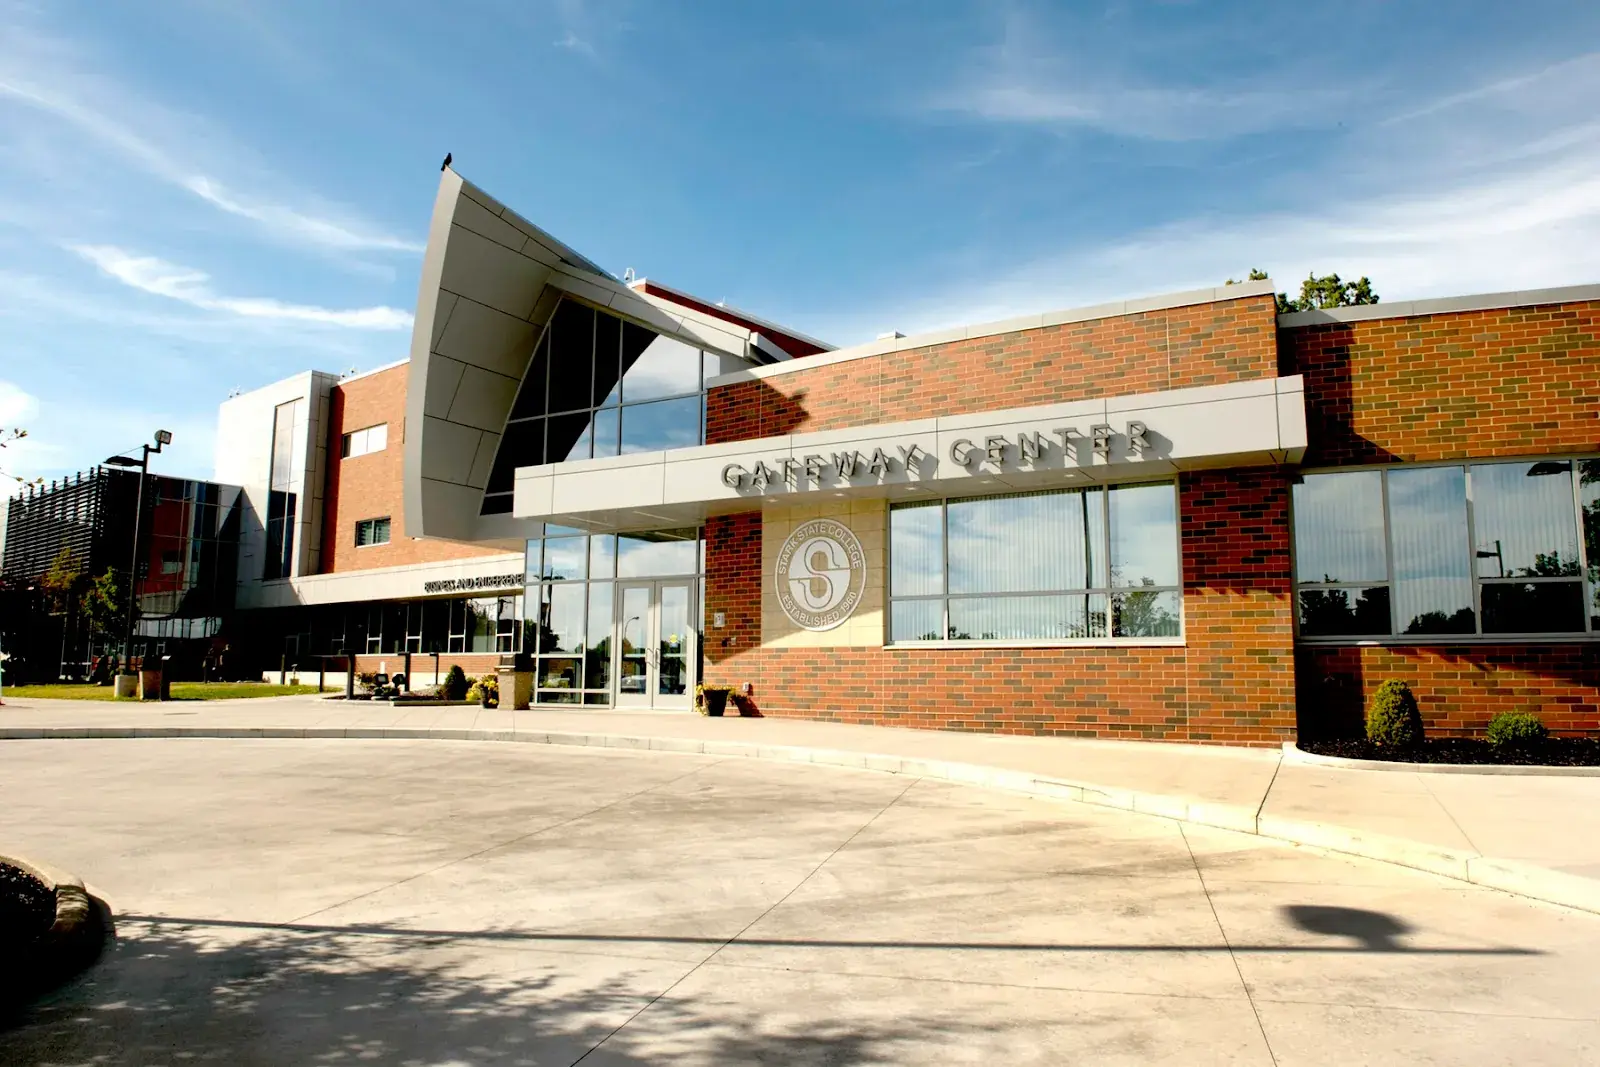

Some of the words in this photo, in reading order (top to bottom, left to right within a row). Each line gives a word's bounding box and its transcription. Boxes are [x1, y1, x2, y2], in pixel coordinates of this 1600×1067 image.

[721, 444, 917, 488] GATEWAY
[950, 420, 1152, 466] CENTER
[779, 538, 798, 575] STARK
[798, 523, 826, 540] STATE
[828, 525, 861, 569] COLLEGE
[424, 580, 456, 593] BUSINESS
[456, 578, 475, 590] AND
[782, 594, 840, 626] ESTABLISHED
[840, 591, 857, 612] 1960
